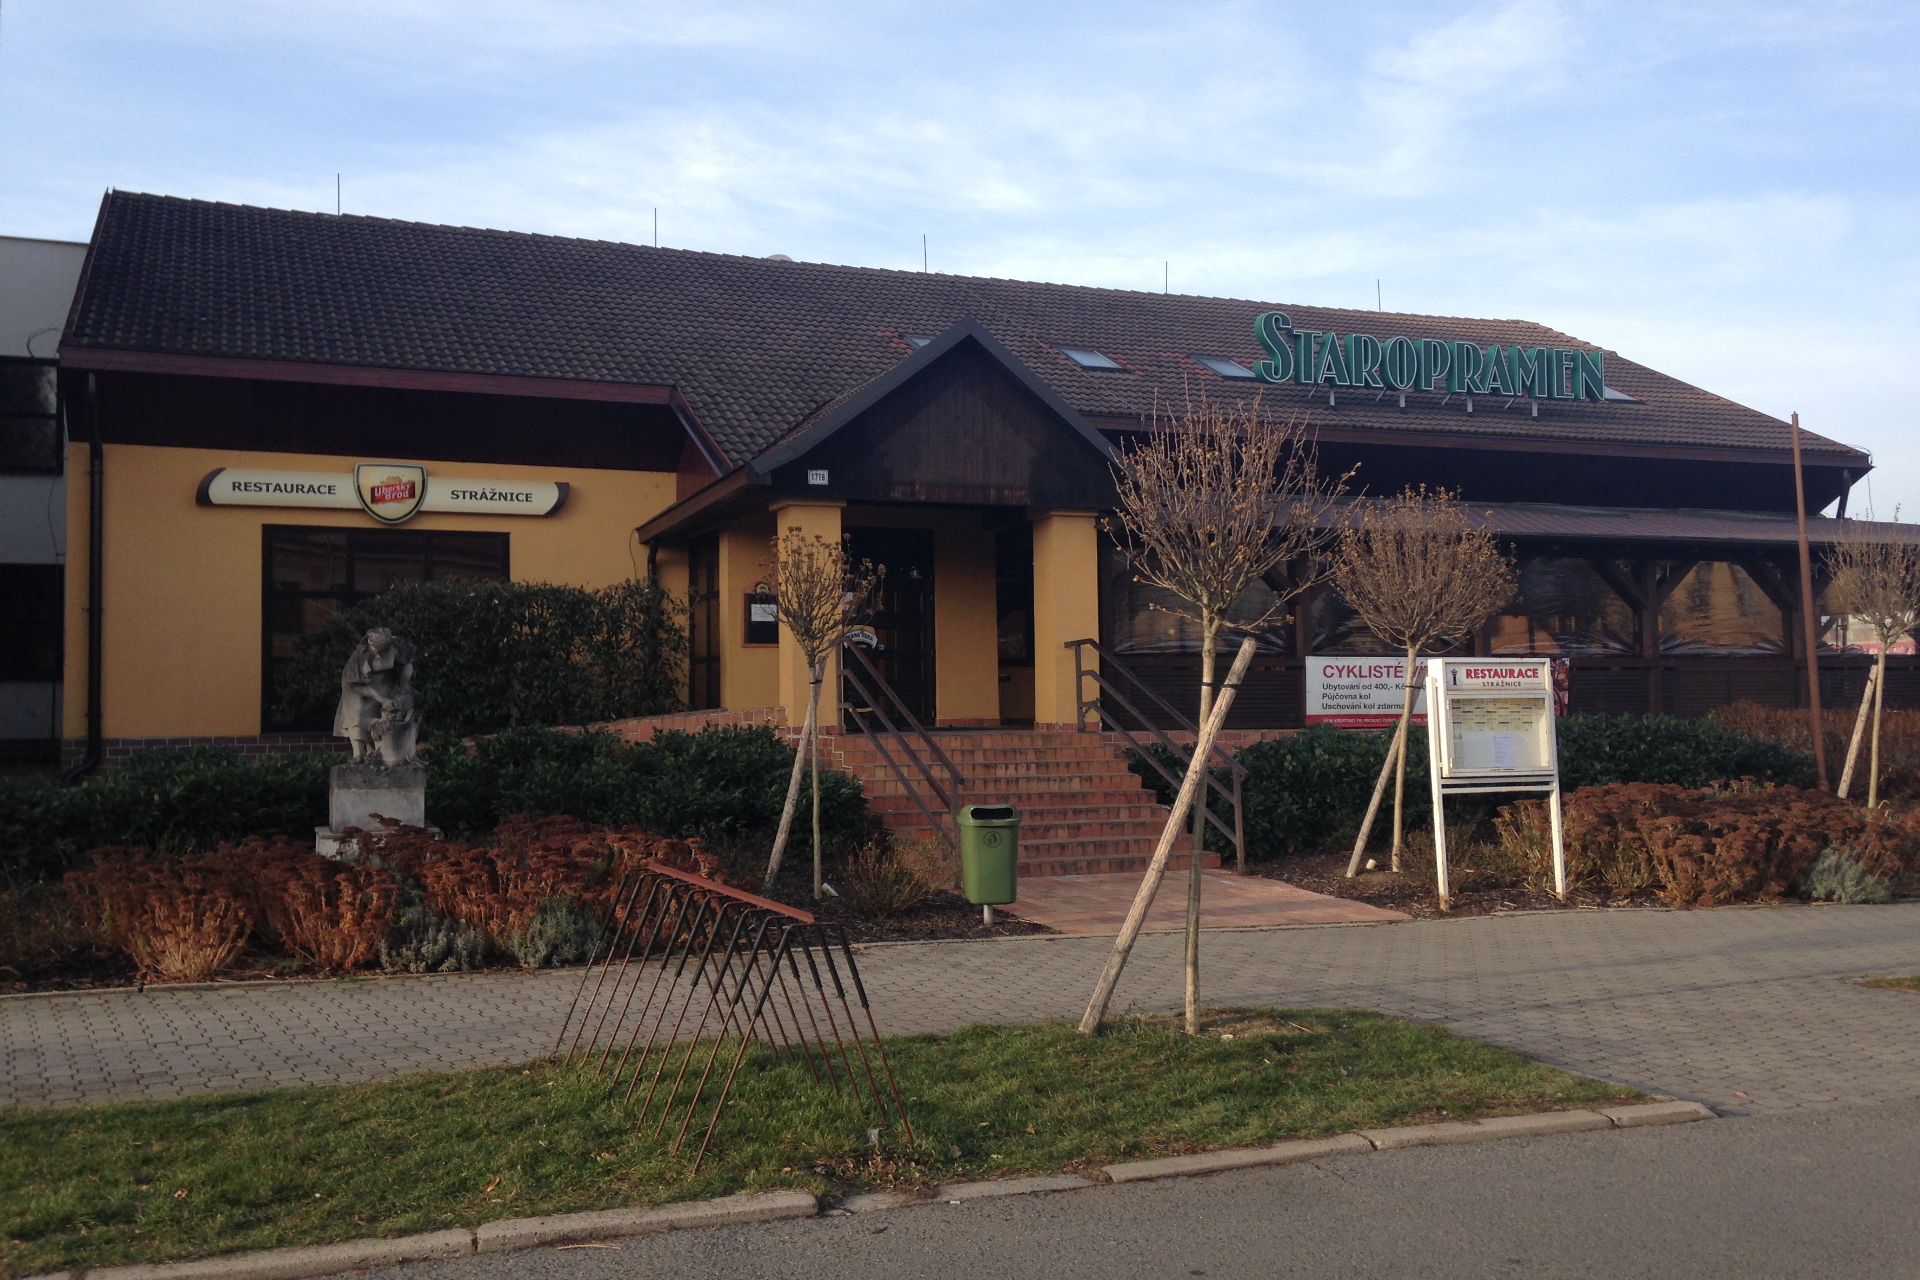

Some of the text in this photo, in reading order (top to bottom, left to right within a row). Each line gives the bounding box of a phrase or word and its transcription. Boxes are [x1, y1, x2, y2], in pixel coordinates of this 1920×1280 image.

[1254, 311, 1604, 400] STAROPRAMEN
[232, 481, 336, 495] RESTAURACE
[385, 490, 409, 500] Brod
[450, 488, 533, 502] STRÁŽNICE
[1322, 662, 1404, 678] CYKLISTÉ
[1466, 668, 1539, 679] RESTAURACE
[1322, 683, 1360, 692] Ubytování
[1322, 693, 1358, 701] Půjčovna
[1322, 702, 1361, 710] Uschování
[1377, 702, 1405, 710] zdarma
